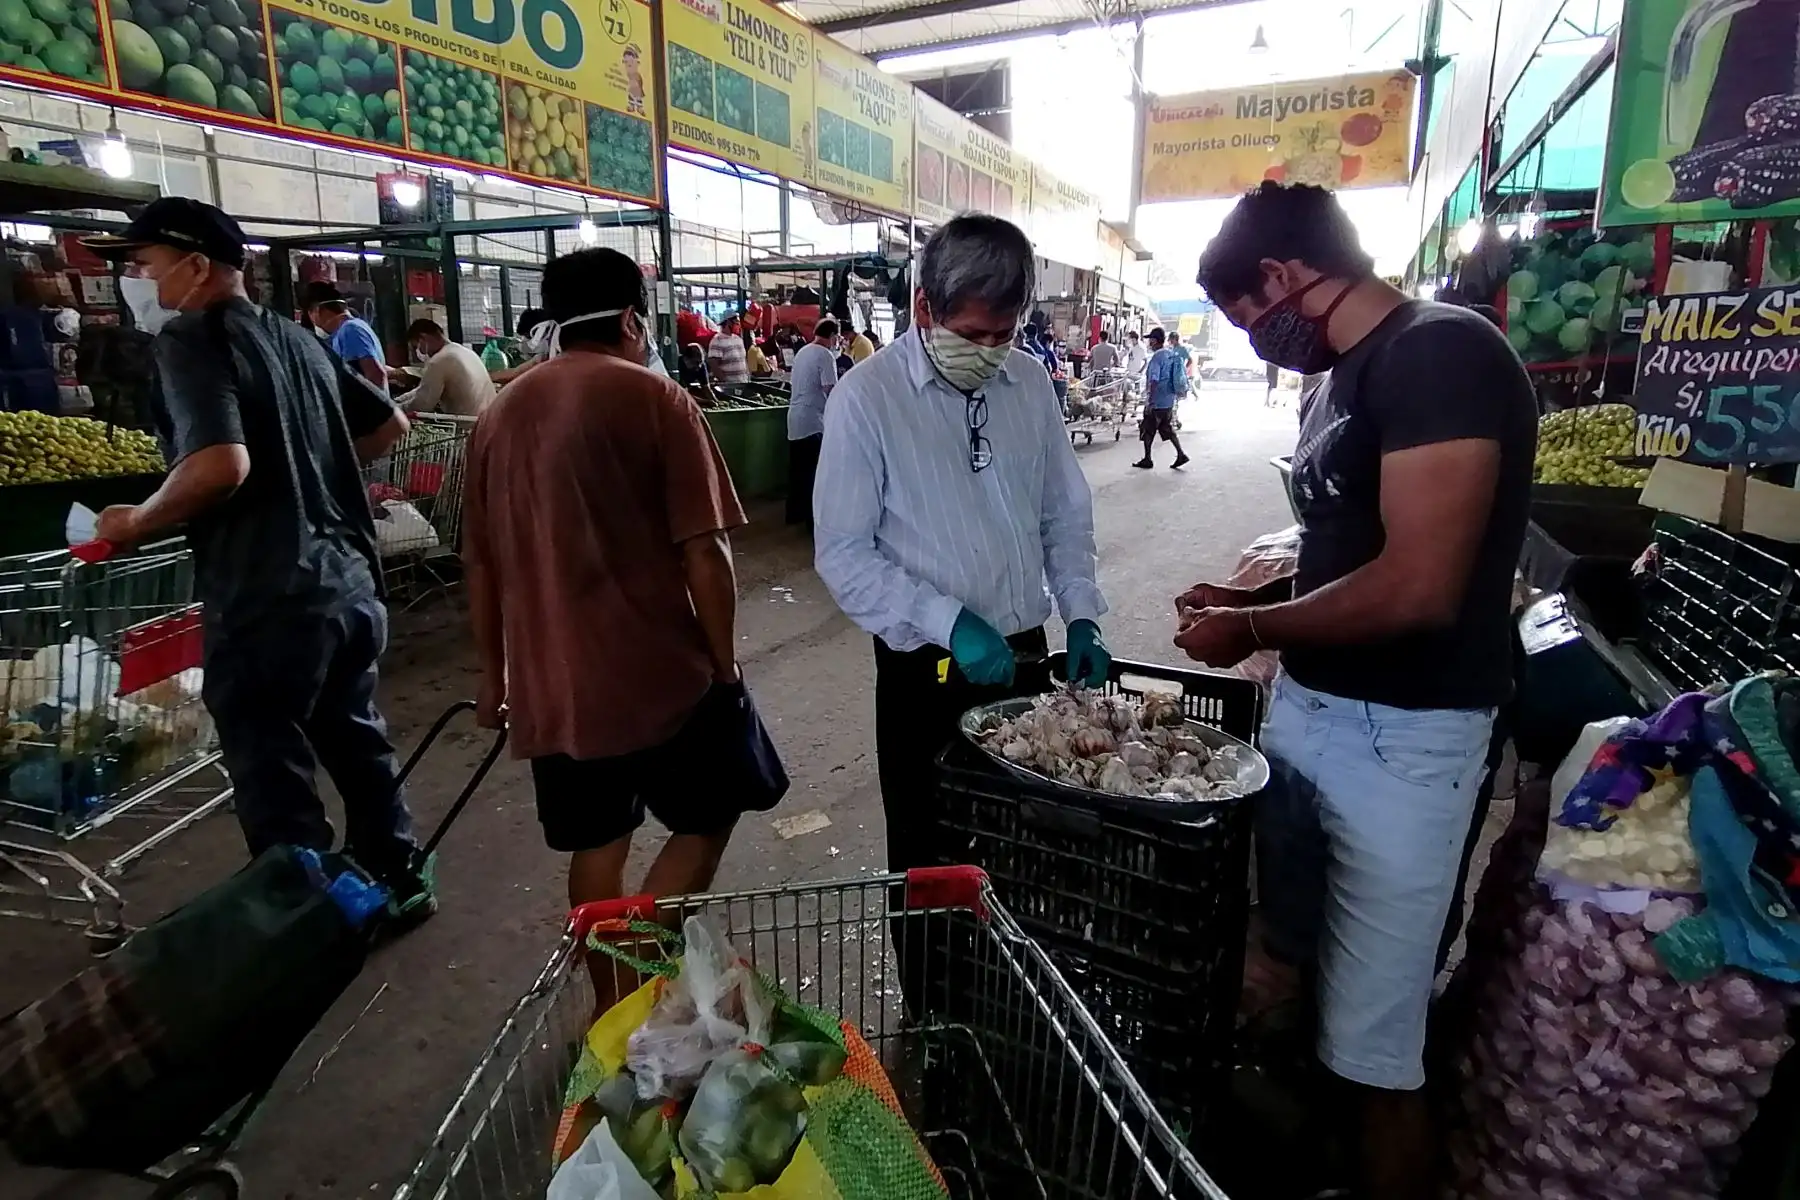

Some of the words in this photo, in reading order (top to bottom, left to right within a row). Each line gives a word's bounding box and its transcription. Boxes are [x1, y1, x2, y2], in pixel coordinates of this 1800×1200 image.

[319, 0, 370, 25] TODOS
[374, 17, 401, 35] LOS
[404, 26, 480, 61] PRODUCTOS
[482, 50, 499, 66] DE
[536, 69, 577, 91] CALIDAD
[604, 16, 627, 38] 71
[726, 2, 789, 54] LIMONES
[855, 68, 896, 105] LIMONES
[1236, 85, 1376, 122] Mayorista
[967, 129, 1012, 164] OLLUCOS
[1153, 138, 1226, 156] Mayorista
[1231, 132, 1281, 148] Olluco
[1642, 292, 1750, 344] MAIZ
[1635, 413, 1692, 458] Kilo
